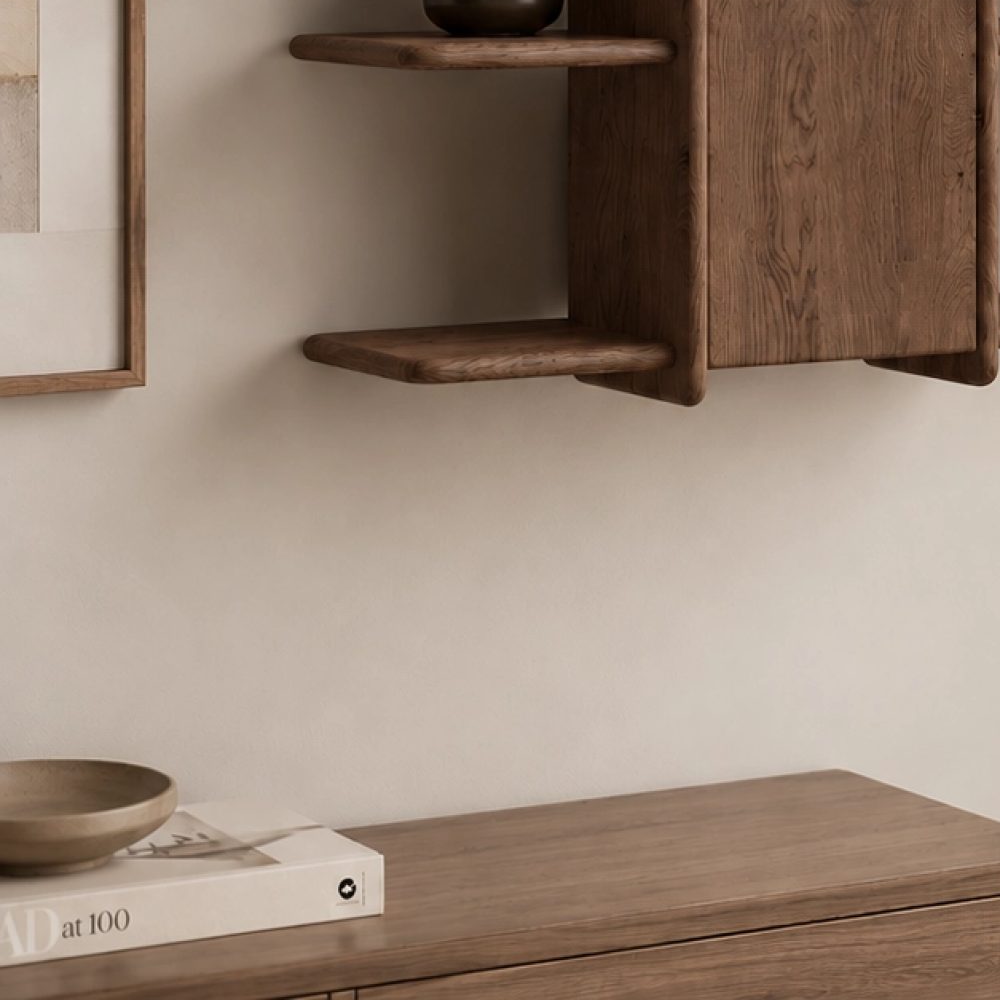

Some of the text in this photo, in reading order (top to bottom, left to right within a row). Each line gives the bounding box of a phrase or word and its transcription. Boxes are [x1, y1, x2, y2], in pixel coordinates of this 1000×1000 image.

[0, 907, 131, 958] AD at 100
